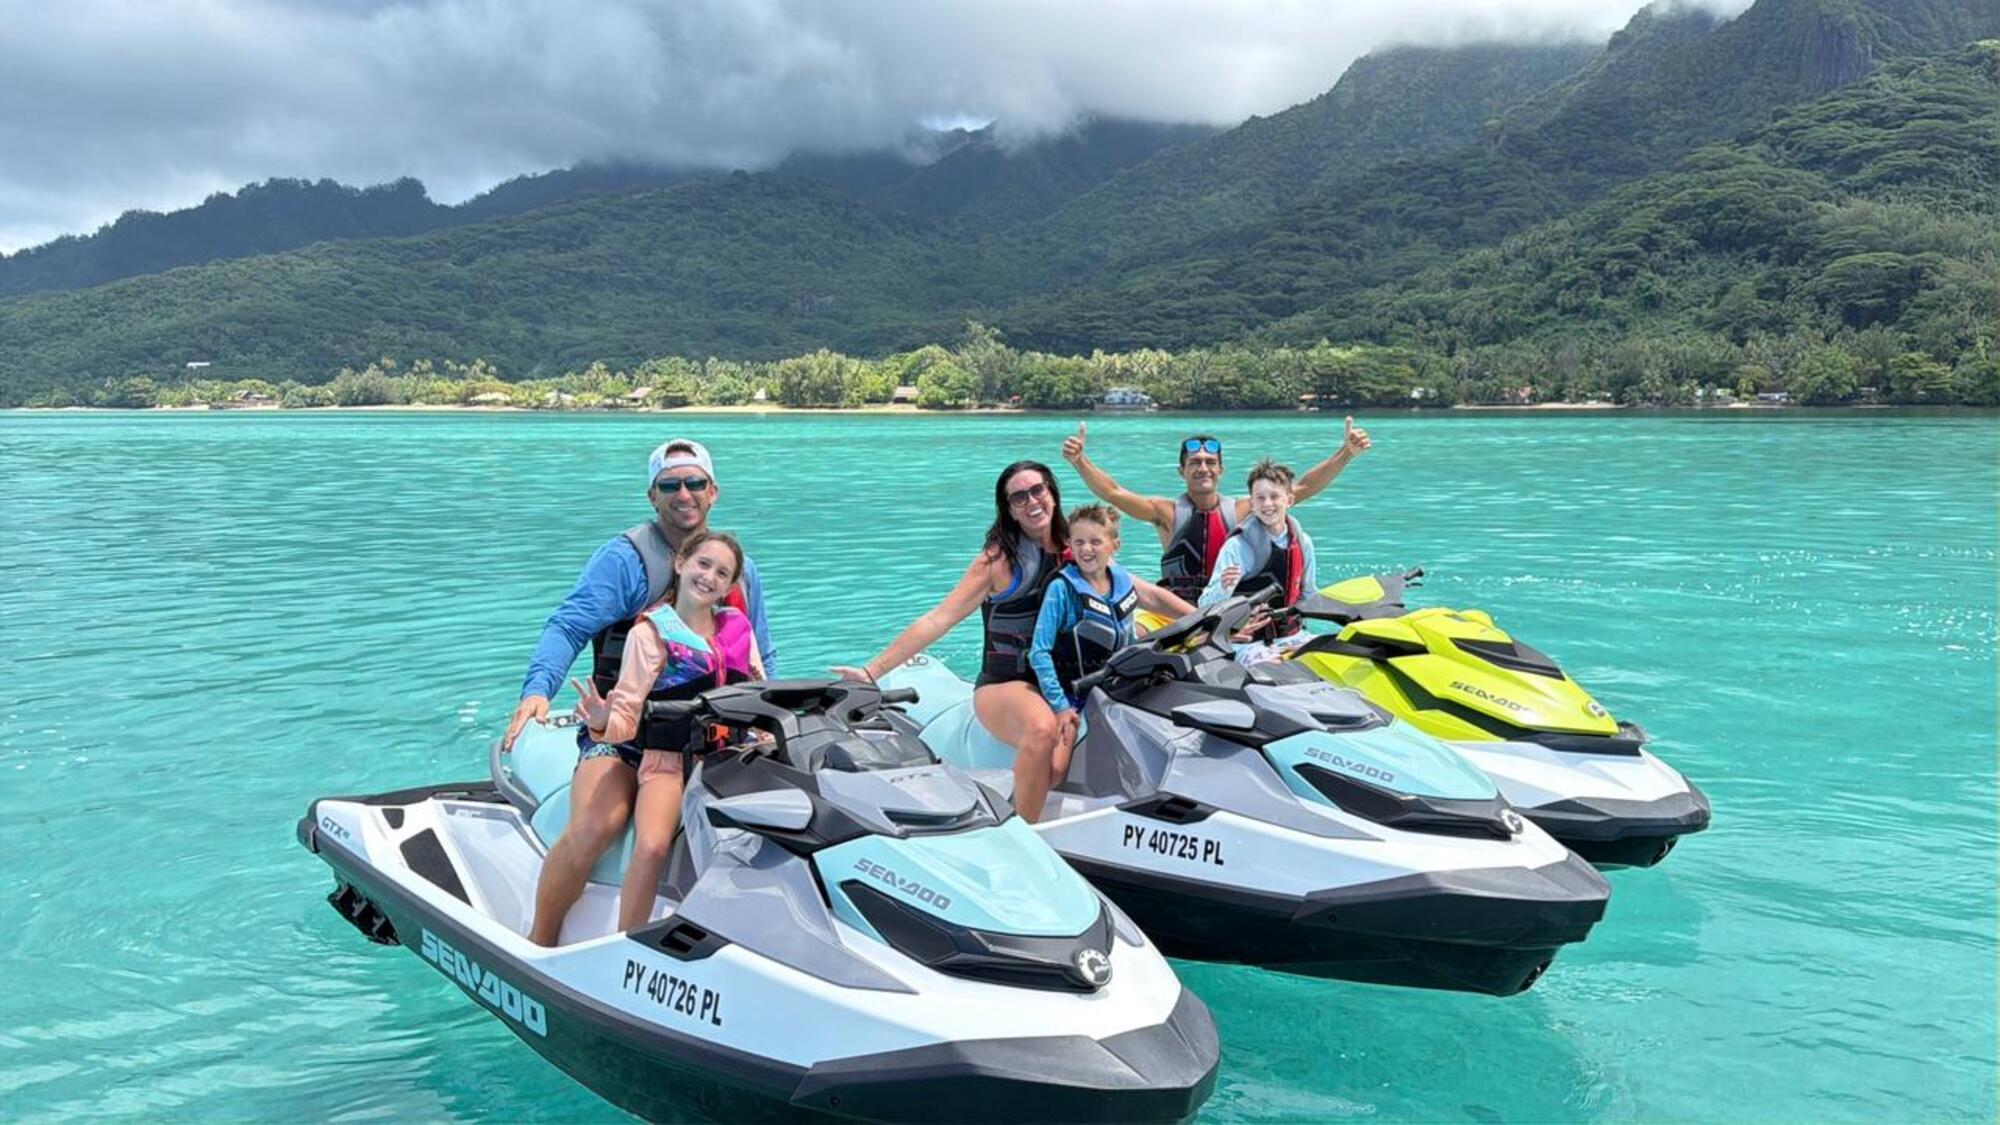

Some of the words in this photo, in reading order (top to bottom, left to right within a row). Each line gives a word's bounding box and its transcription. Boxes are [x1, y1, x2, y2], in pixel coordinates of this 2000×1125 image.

[322, 816, 344, 839] GTX
[1123, 824, 1145, 849] PY
[1148, 829, 1198, 860] 40725
[1203, 839, 1224, 866] PL
[623, 959, 646, 994] PY
[647, 970, 698, 1015] 40726
[700, 988, 722, 1026] PL
